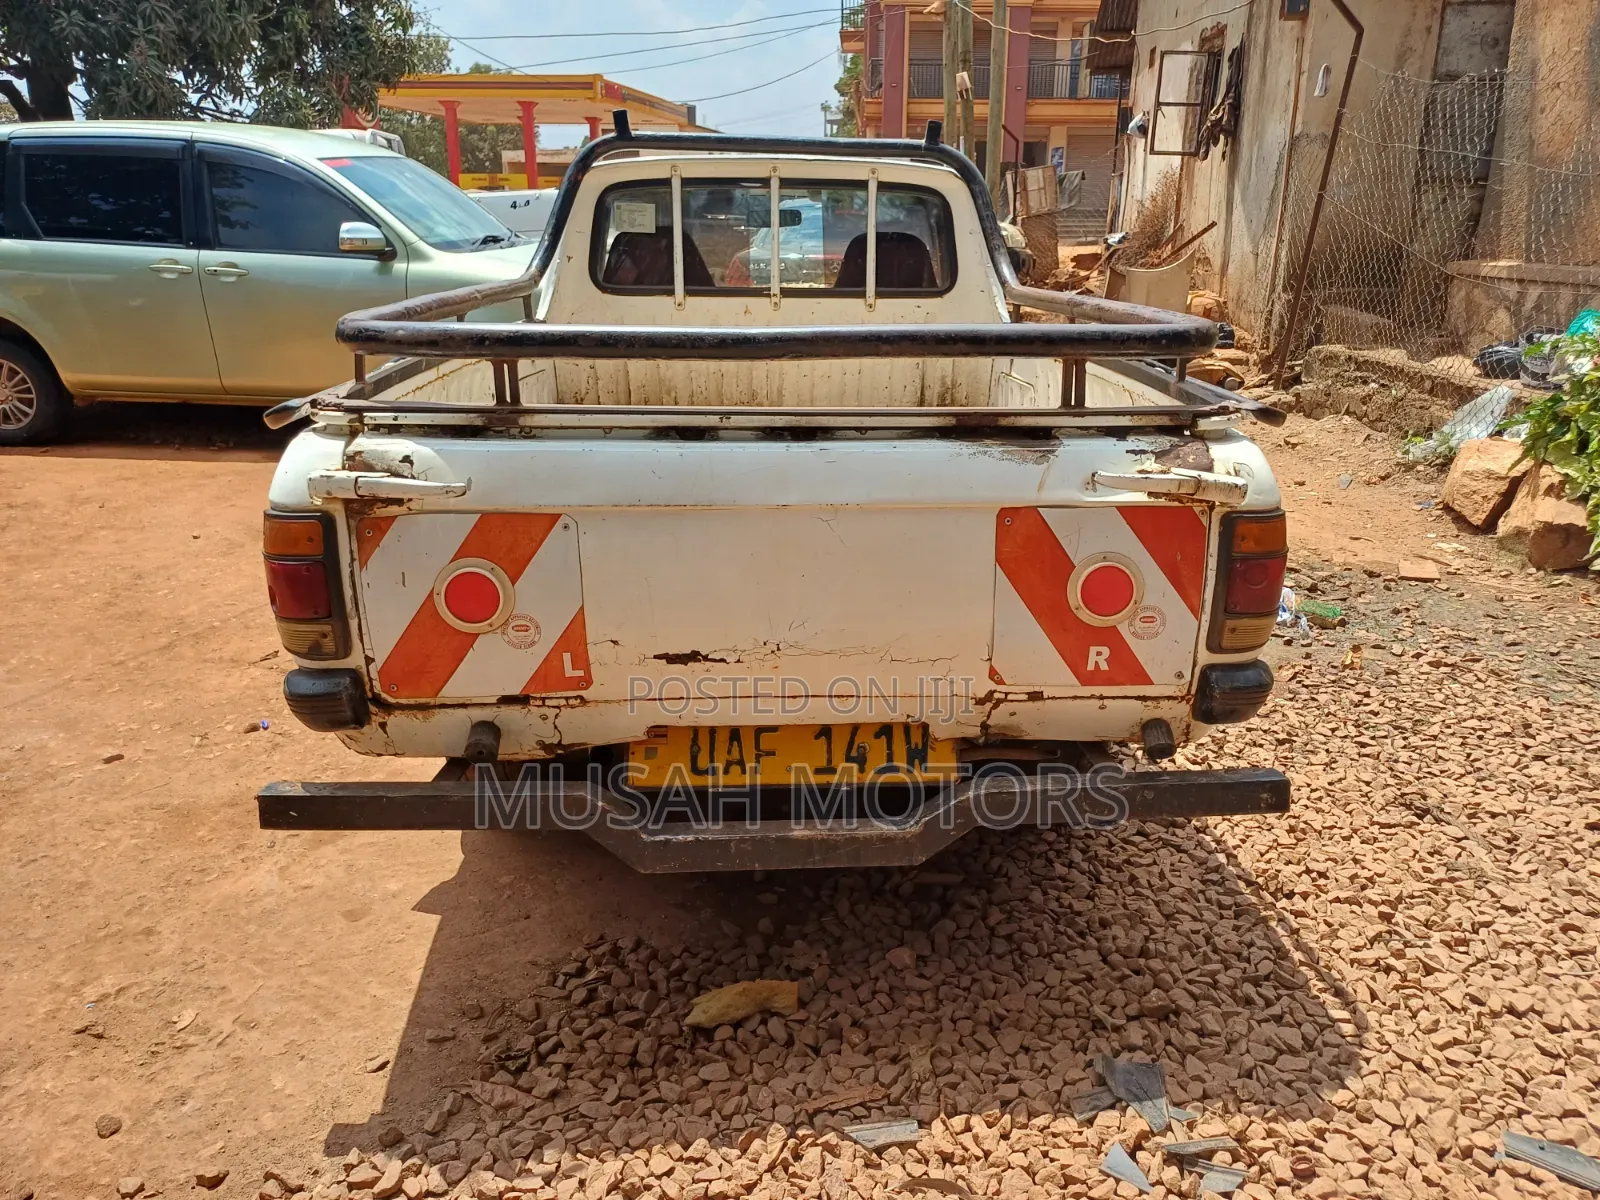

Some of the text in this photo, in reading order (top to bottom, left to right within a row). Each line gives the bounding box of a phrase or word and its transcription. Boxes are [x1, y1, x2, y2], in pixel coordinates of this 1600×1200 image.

[562, 652, 585, 678] L
[1086, 646, 1111, 671] R
[689, 726, 780, 777] UAF
